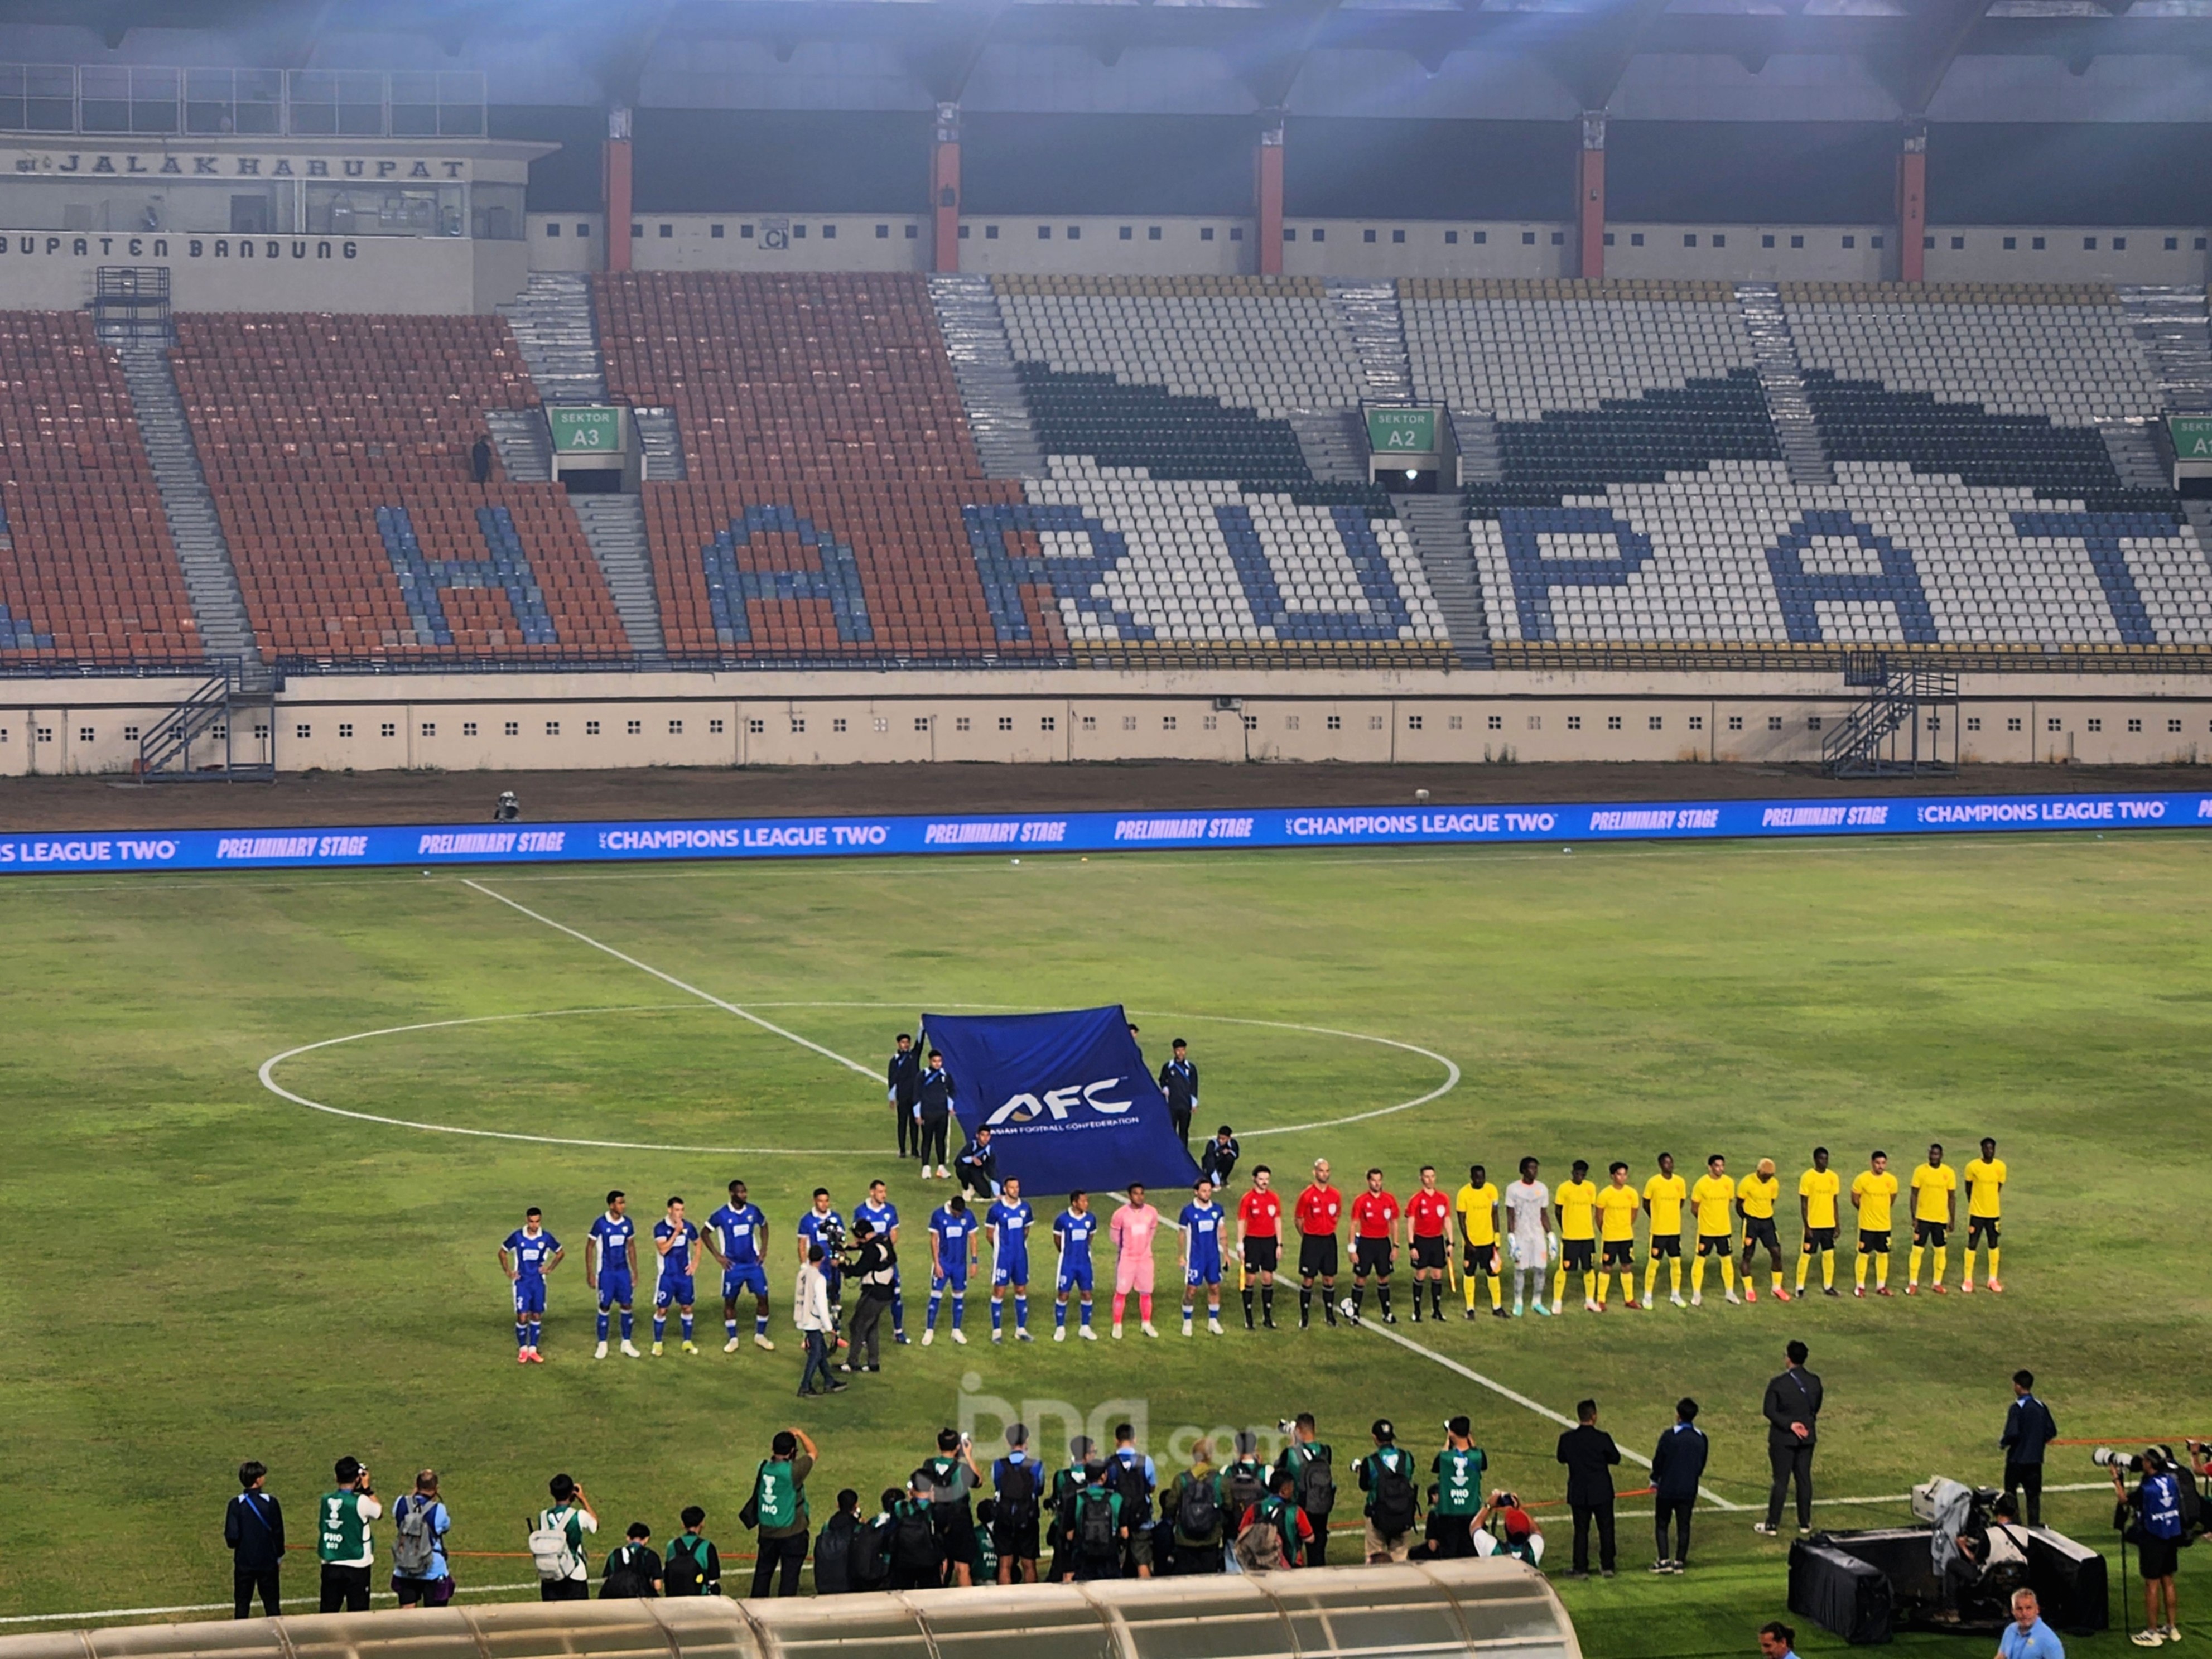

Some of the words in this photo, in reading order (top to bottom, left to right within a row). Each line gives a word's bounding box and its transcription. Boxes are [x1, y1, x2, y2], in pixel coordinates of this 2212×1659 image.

[59, 155, 218, 174] JALAK
[237, 158, 464, 177] HARUPAT
[189, 240, 358, 259] BANDUNG
[561, 413, 610, 422] SEKTOR
[1377, 414, 1425, 424] SEKTOR
[2181, 422, 2212, 431] SEKT
[572, 429, 599, 446] A3
[1387, 430, 1415, 447] A2
[1590, 811, 1676, 830] PRELIMINARY
[1678, 809, 1719, 828] STAGE
[1762, 807, 1846, 826] PRELIMINARY
[1847, 807, 1888, 824] STAGE
[1925, 804, 2037, 822] CHAMPIONS
[2042, 802, 2113, 819] LEAGUE
[2118, 802, 2164, 818] TWO
[925, 823, 1019, 843] PRELIMINARY
[1020, 822, 1066, 841] STAGE
[1115, 819, 1207, 839] PRELIMINARY
[1208, 818, 1253, 837] STAGE
[1294, 816, 1417, 835] CHAMPIONS
[1423, 814, 1499, 832] LEAGUE
[1505, 813, 1554, 831] TWO
[218, 837, 317, 858] PRELIMINARY
[317, 836, 368, 856] STAGE
[419, 833, 516, 853] PRELIMINARY
[518, 832, 565, 852] STAGE
[608, 830, 739, 849] CHAMPIONS
[744, 827, 827, 846] LEAGUE
[832, 826, 886, 844] TWO
[21, 842, 110, 861] LEAGUE
[117, 841, 174, 859] TWO
[985, 1078, 1133, 1125] AFC
[990, 1127, 1018, 1135] ASIAN
[1019, 1124, 1064, 1134] FOOTBALL
[1065, 1116, 1139, 1131] CONFEDERATION
[1450, 1488, 1469, 1499] PHO
[324, 1532, 343, 1543] PHO
